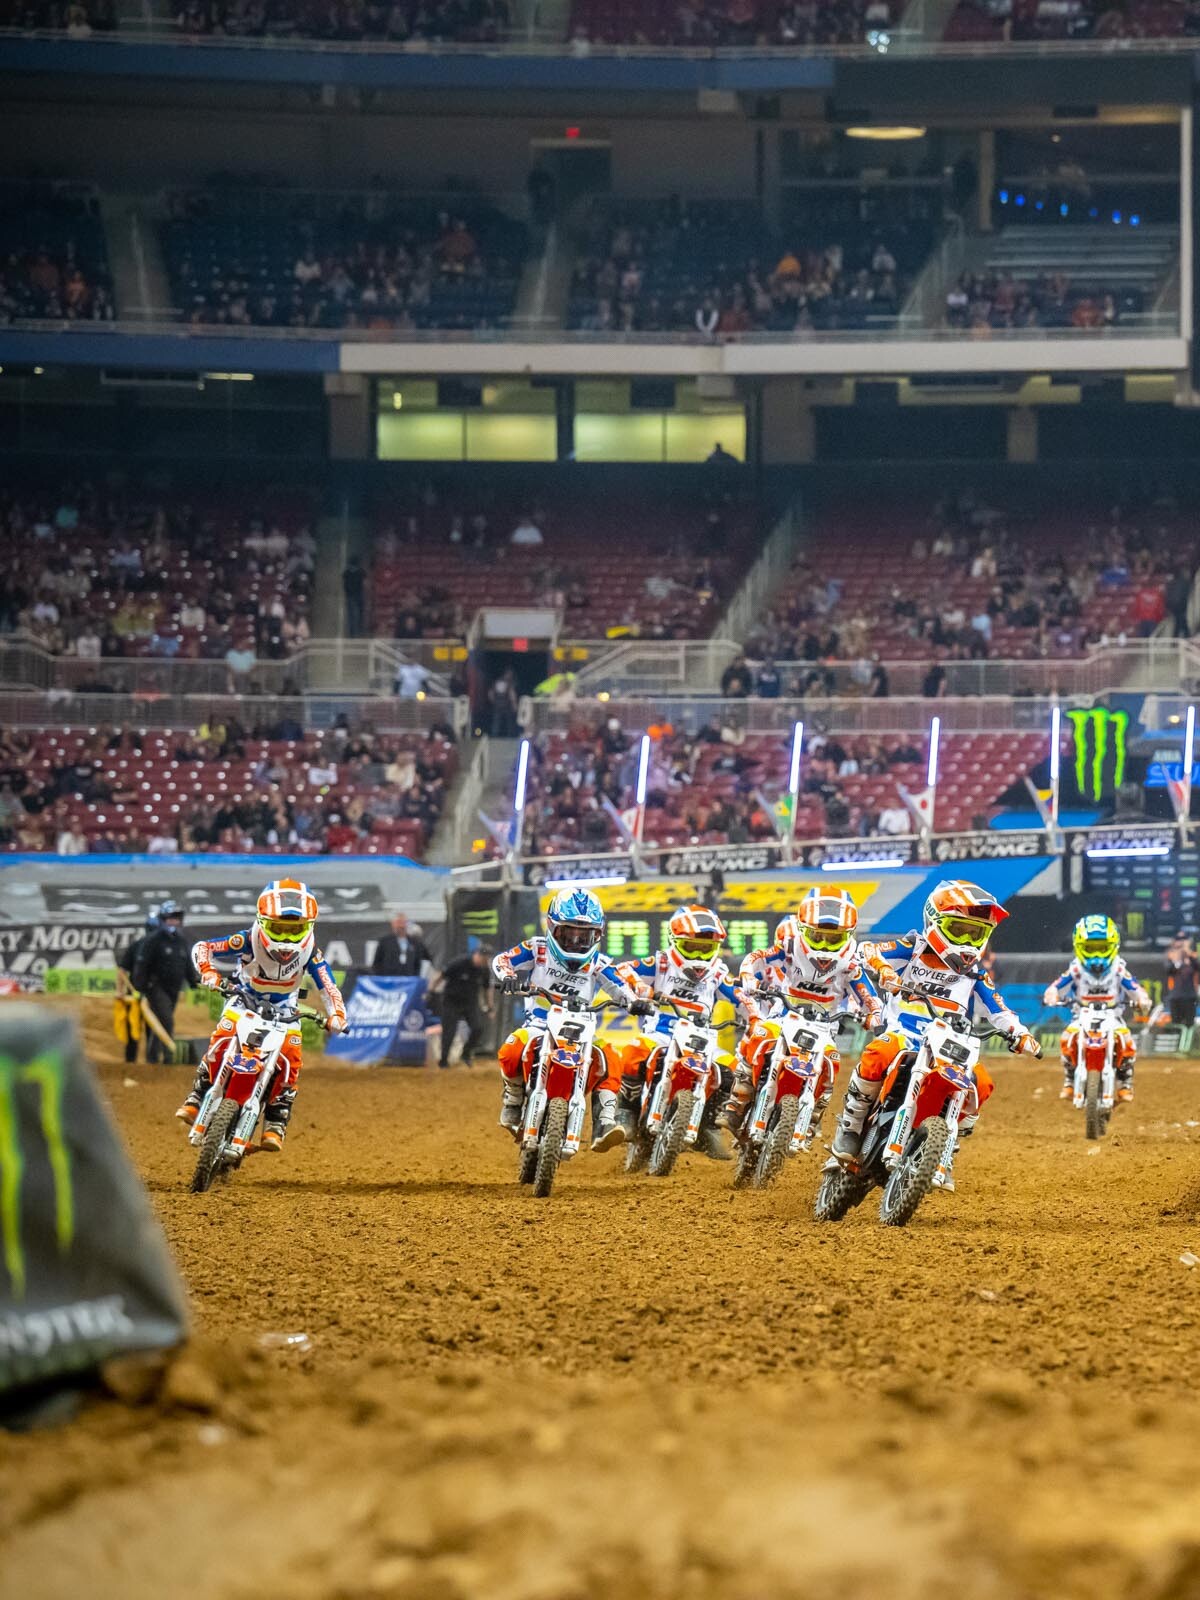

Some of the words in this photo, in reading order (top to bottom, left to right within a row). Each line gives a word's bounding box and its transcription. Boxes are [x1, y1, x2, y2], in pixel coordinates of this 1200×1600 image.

[546, 967, 566, 981] TROY
[566, 974, 579, 984] LEE
[911, 965, 931, 979] TROY
[931, 971, 947, 983] LEE
[549, 982, 581, 997] KTM
[670, 988, 700, 1002] KTM
[797, 981, 829, 995] KTM
[919, 981, 952, 999] KTM
